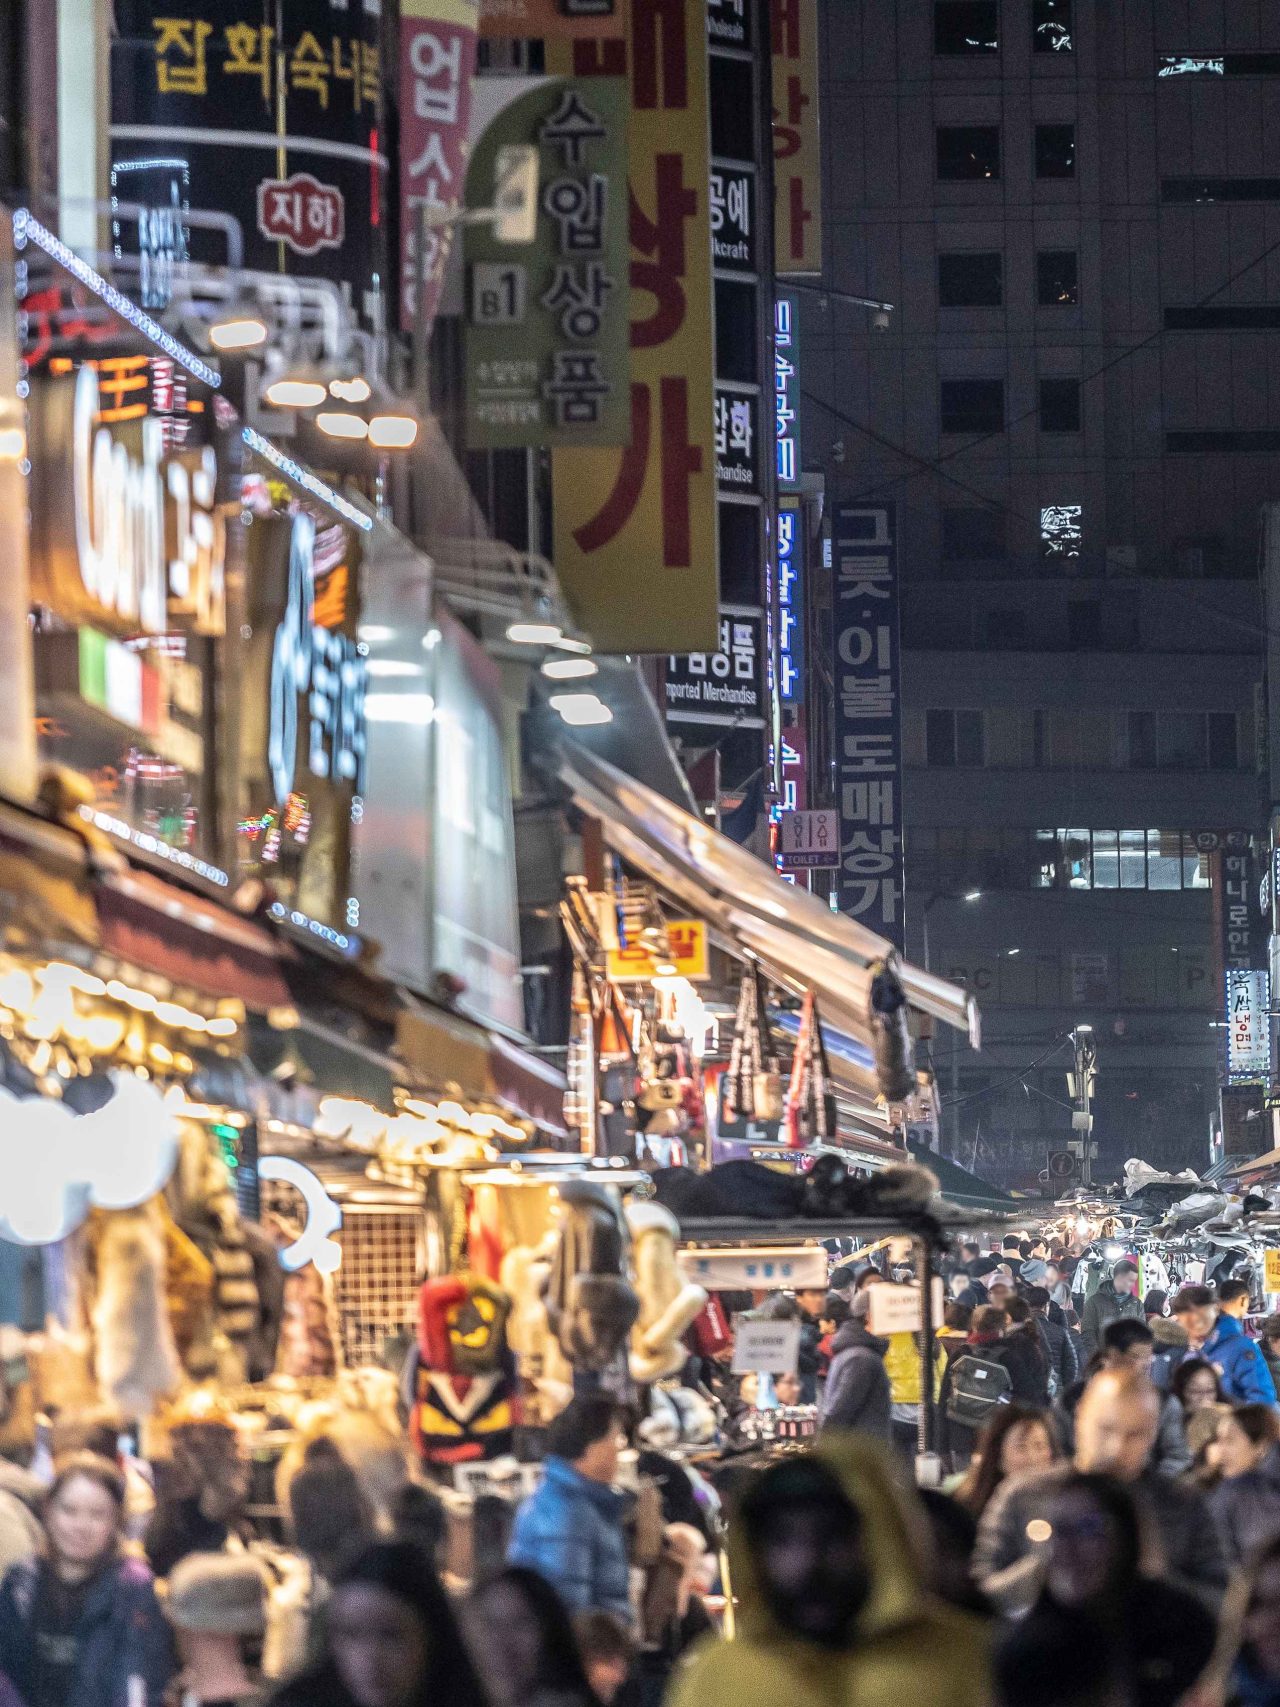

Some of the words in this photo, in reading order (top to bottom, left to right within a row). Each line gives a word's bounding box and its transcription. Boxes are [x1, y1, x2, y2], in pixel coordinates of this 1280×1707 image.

[152, 17, 276, 100] 잡화
[269, 190, 334, 237] 지하
[545, 92, 618, 423] 수입상품
[787, 855, 820, 866] TOILET
